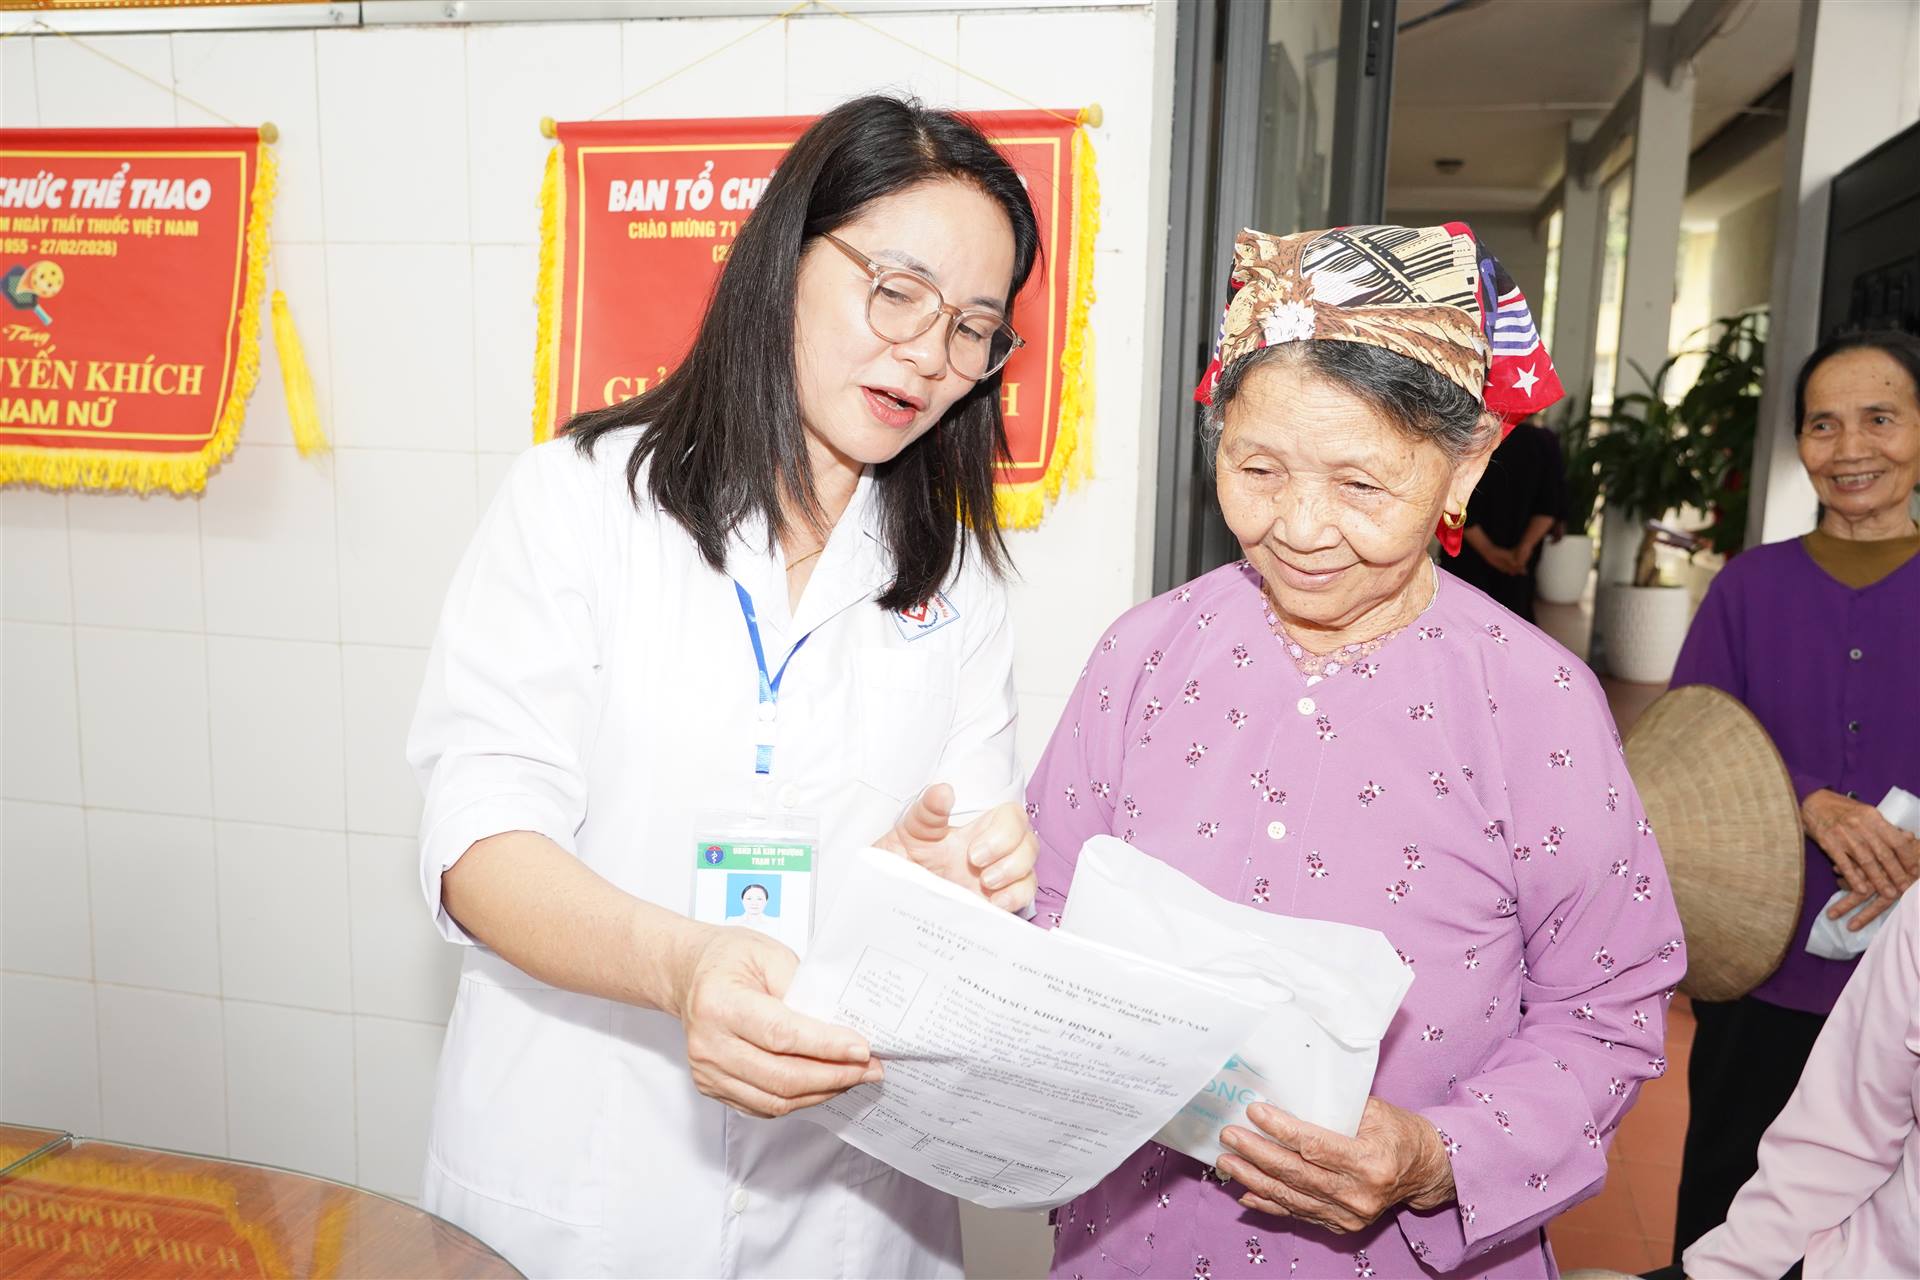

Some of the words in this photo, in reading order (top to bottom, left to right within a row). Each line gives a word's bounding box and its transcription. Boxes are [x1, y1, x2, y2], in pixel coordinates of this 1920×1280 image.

[69, 162, 130, 209] THỂ
[128, 178, 212, 211] THAO
[608, 179, 669, 213] BAN
[674, 160, 714, 212] TỔ
[12, 214, 49, 233] NGÀY
[87, 213, 130, 235] THUỐC
[132, 216, 161, 238] VIỆT
[164, 219, 199, 237] NAM
[628, 219, 667, 239] CHÀO
[671, 217, 716, 238] MỪNG
[719, 221, 737, 238] 71
[0, 344, 78, 390] YẾN
[85, 354, 204, 396] KHÍCH
[66, 396, 117, 428] NỮ
